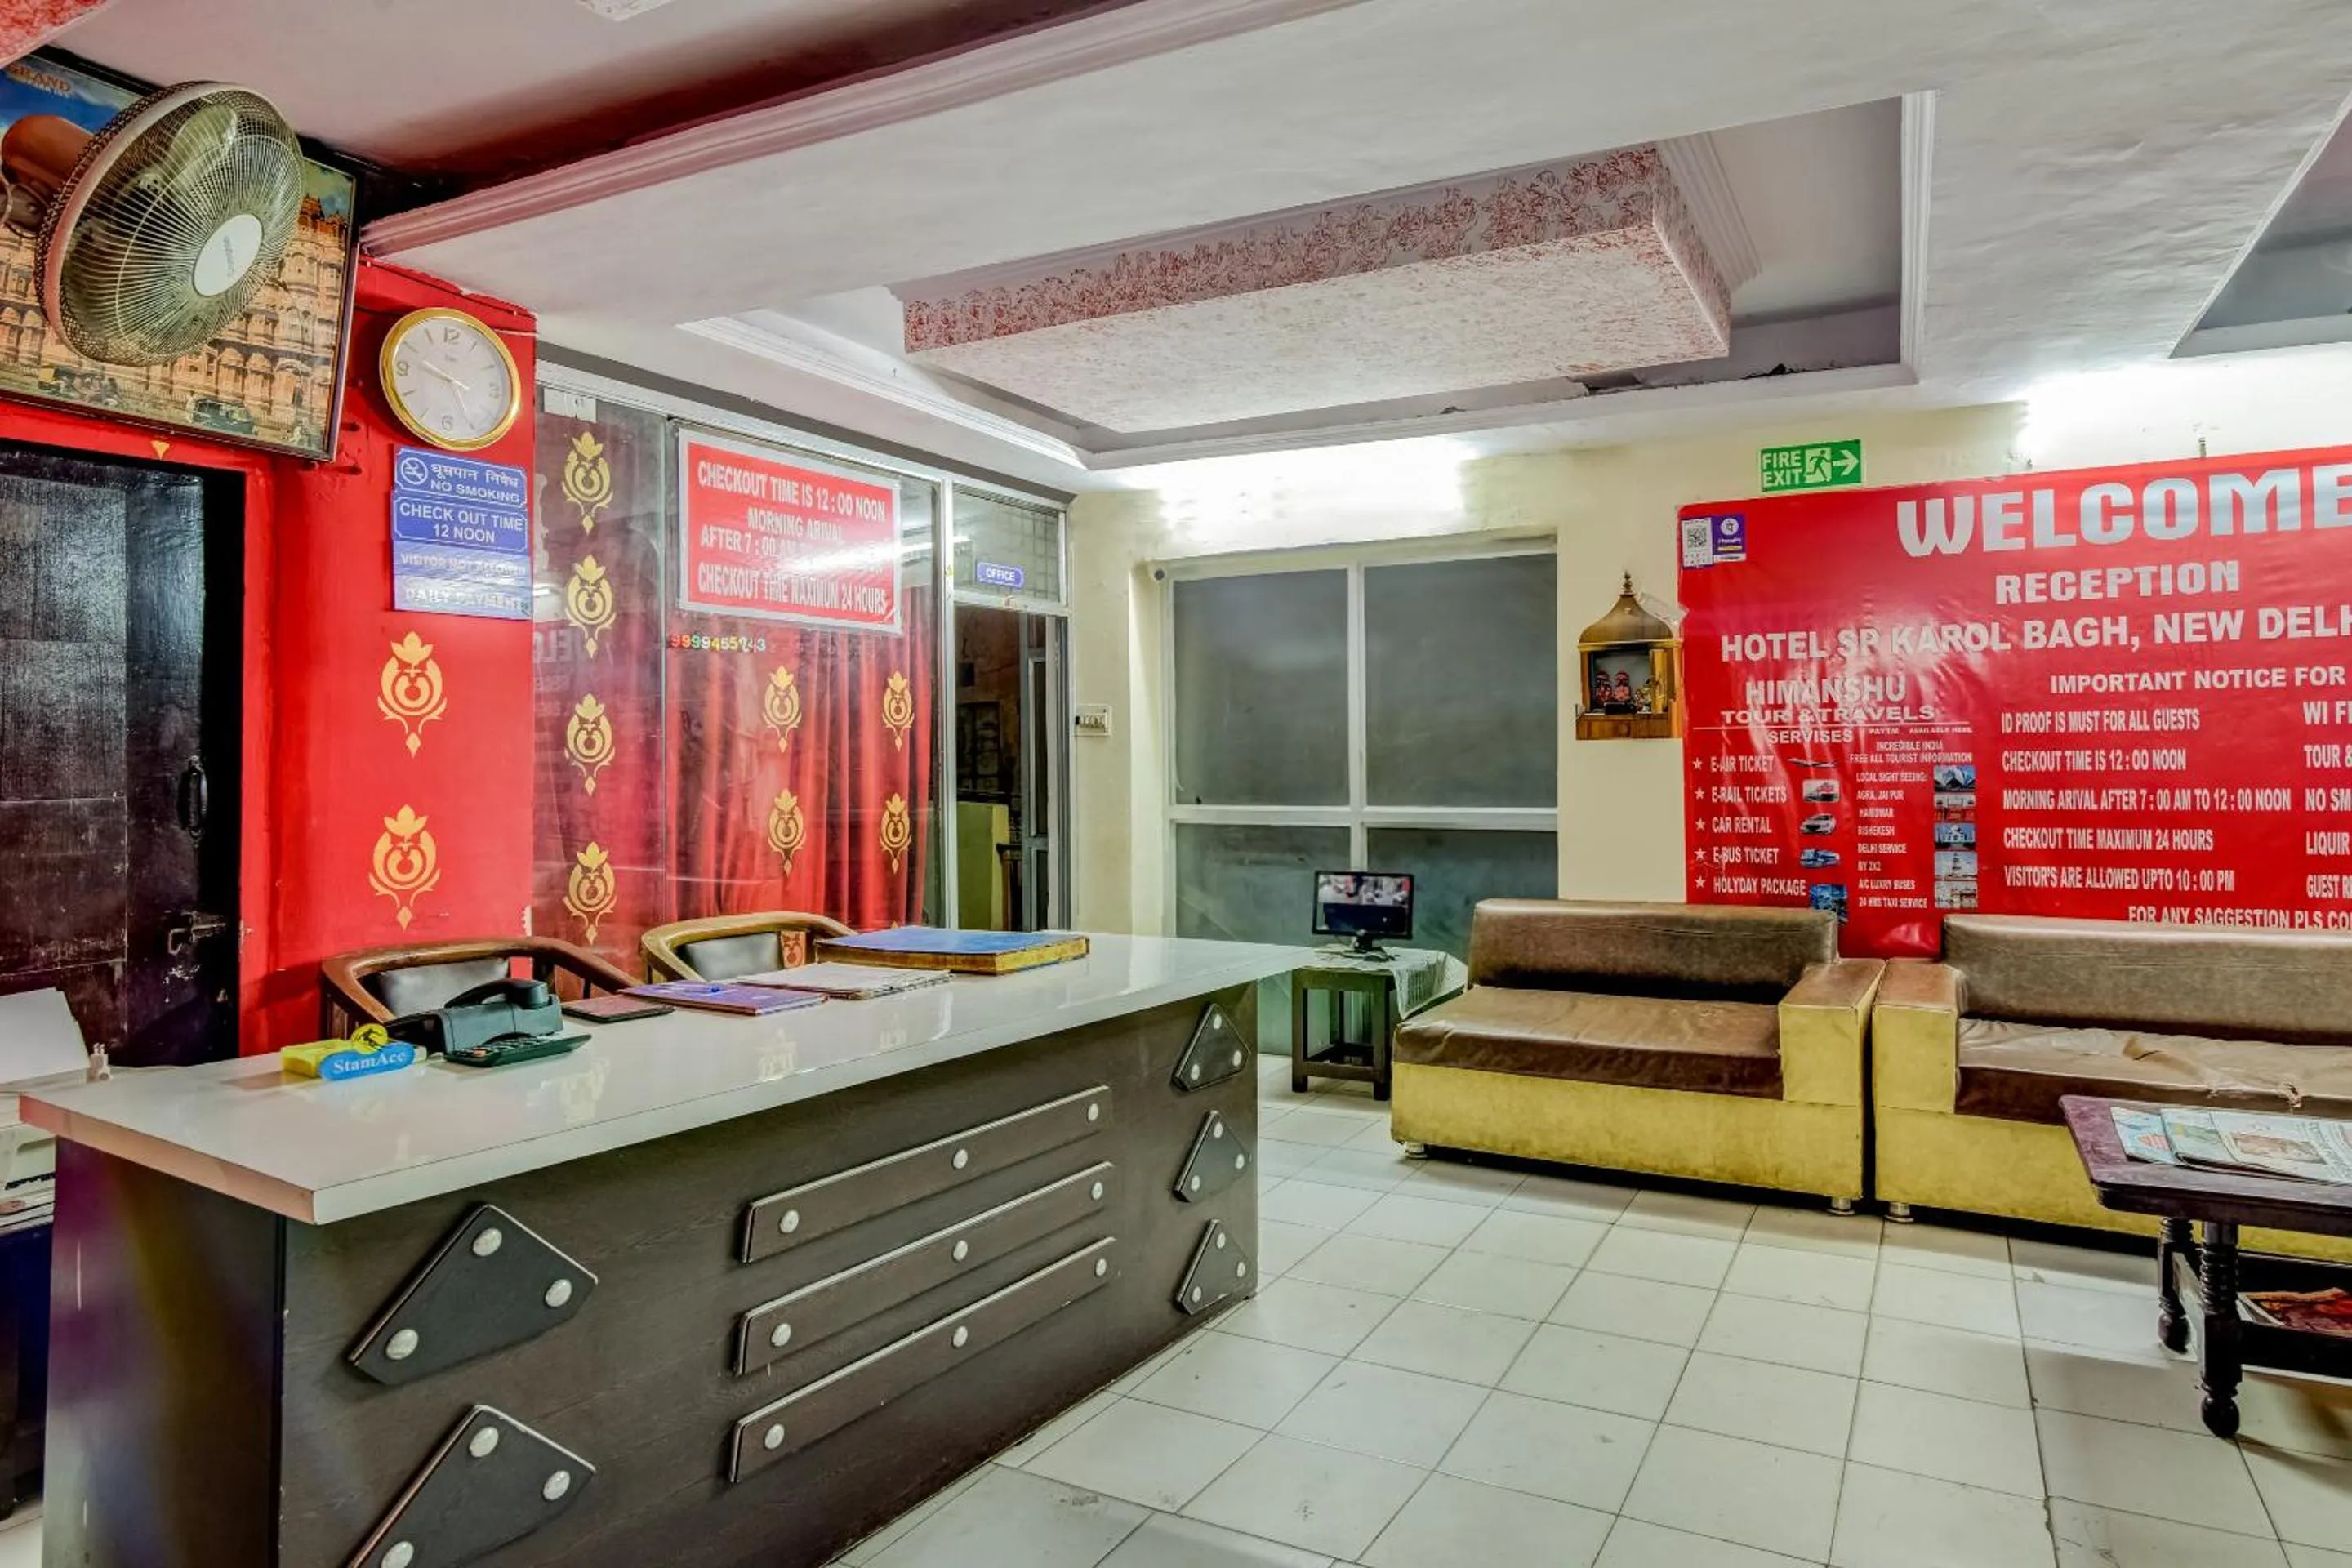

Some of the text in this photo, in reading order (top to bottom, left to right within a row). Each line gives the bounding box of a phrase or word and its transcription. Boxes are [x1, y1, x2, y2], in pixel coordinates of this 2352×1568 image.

[443, 327, 460, 345] 12
[397, 361, 409, 377] 9
[1762, 450, 1802, 470] FIRE
[1763, 468, 1803, 488] EXIT
[430, 479, 520, 503] NO SMOKING
[698, 461, 768, 499] CHECKOUT
[770, 477, 799, 506] TIME
[801, 483, 813, 509] IS
[856, 498, 886, 523] NOON
[399, 502, 523, 531] CHECK OUT TIME
[747, 507, 804, 538] MORNING
[1896, 464, 2352, 558] WELCOME
[433, 523, 496, 543] 12 NOON
[701, 525, 742, 552] AFTER
[986, 567, 1016, 582] OFFICE
[1995, 560, 2239, 605] RECEPTION
[697, 561, 760, 599] CHECKOUT
[841, 584, 853, 611] 24
[854, 585, 888, 615] HOURS
[1721, 630, 1829, 662] HOTEL
[1891, 621, 2011, 657] KAROL
[2024, 615, 2140, 653] BAGH,
[2154, 609, 2245, 644] NEW
[1745, 675, 1906, 706] HIMANSHU
[2050, 665, 2346, 694] IMPORTANT NOTICE FOR
[1720, 709, 1793, 724] TOUR
[2001, 707, 2200, 734] ID PROOF IS MUST FOR ALL GUESTS
[1768, 729, 1854, 744] SERVISES
[1876, 739, 1944, 751] INCREDIBLE INDIA
[1739, 755, 1774, 773] TICKET
[1850, 751, 1973, 764] FREE ALL TOURIST INFORMATION
[2002, 750, 2063, 773] CHECKOUT
[2065, 750, 2092, 773] TIME
[2095, 749, 2107, 772] IS
[2152, 748, 2187, 771] NOON
[2303, 744, 2341, 768] TOUR
[1855, 772, 1878, 782] LOCAL
[1878, 772, 1899, 782] SIGHT
[1711, 786, 1787, 804] E-RAIL TICKETS
[2002, 789, 2056, 810] MORNING
[2057, 789, 2098, 810] ARIVAL
[2100, 789, 2138, 811] AFTER
[2173, 788, 2191, 811] AM
[2194, 788, 2210, 811] TO
[2255, 788, 2292, 811] NOON
[2305, 788, 2326, 811] NO
[1711, 816, 1773, 834] CAR RENTAL
[1878, 842, 1908, 854] SERVICE
[2003, 827, 2214, 851] CHECKOUT TIME MAXIMUM 24 HOURS
[1713, 846, 1780, 865] E-BUS TICKET
[1713, 876, 1807, 897] HOLYDAY PACKAGE
[2004, 865, 2058, 888] VISITOR'S
[2060, 866, 2083, 889] ARE
[2085, 867, 2139, 890] ALLOWED
[2142, 868, 2173, 891] UPTO
[2217, 869, 2235, 892] PM
[2306, 875, 2341, 898] GUEST
[1898, 897, 1928, 909] SERVICE
[2128, 905, 2157, 924] FOR
[2161, 906, 2191, 925] ANY
[2194, 906, 2291, 929] SAGGESTION
[2294, 909, 2323, 929] PLS
